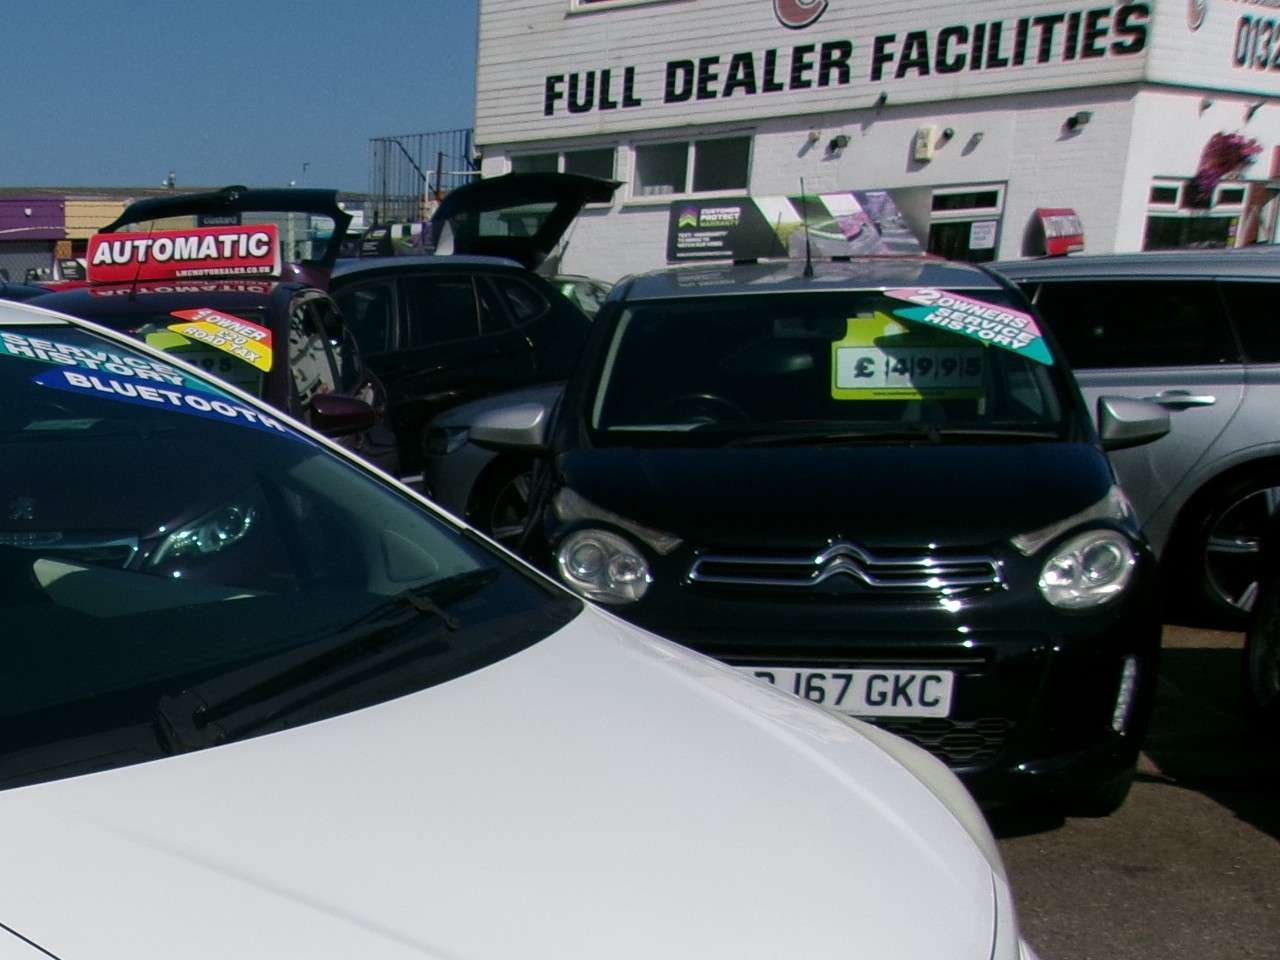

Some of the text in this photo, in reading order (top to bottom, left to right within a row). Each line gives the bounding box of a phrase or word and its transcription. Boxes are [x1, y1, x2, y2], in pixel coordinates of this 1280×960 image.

[544, 3, 1150, 117] FULL DEALER FACILITIES
[93, 232, 270, 265] AUTOMATIC
[908, 289, 1030, 330] 2 OWNERS
[934, 307, 1037, 343] SERVICE
[184, 327, 263, 363] ROAD TAX
[205, 315, 267, 341] OWNER
[924, 314, 1027, 349] HISTORY
[0, 332, 177, 377] SERVICE
[3, 342, 187, 386] HISTORY
[63, 370, 287, 433] BLUETOOTH
[865, 673, 943, 708] GKC
